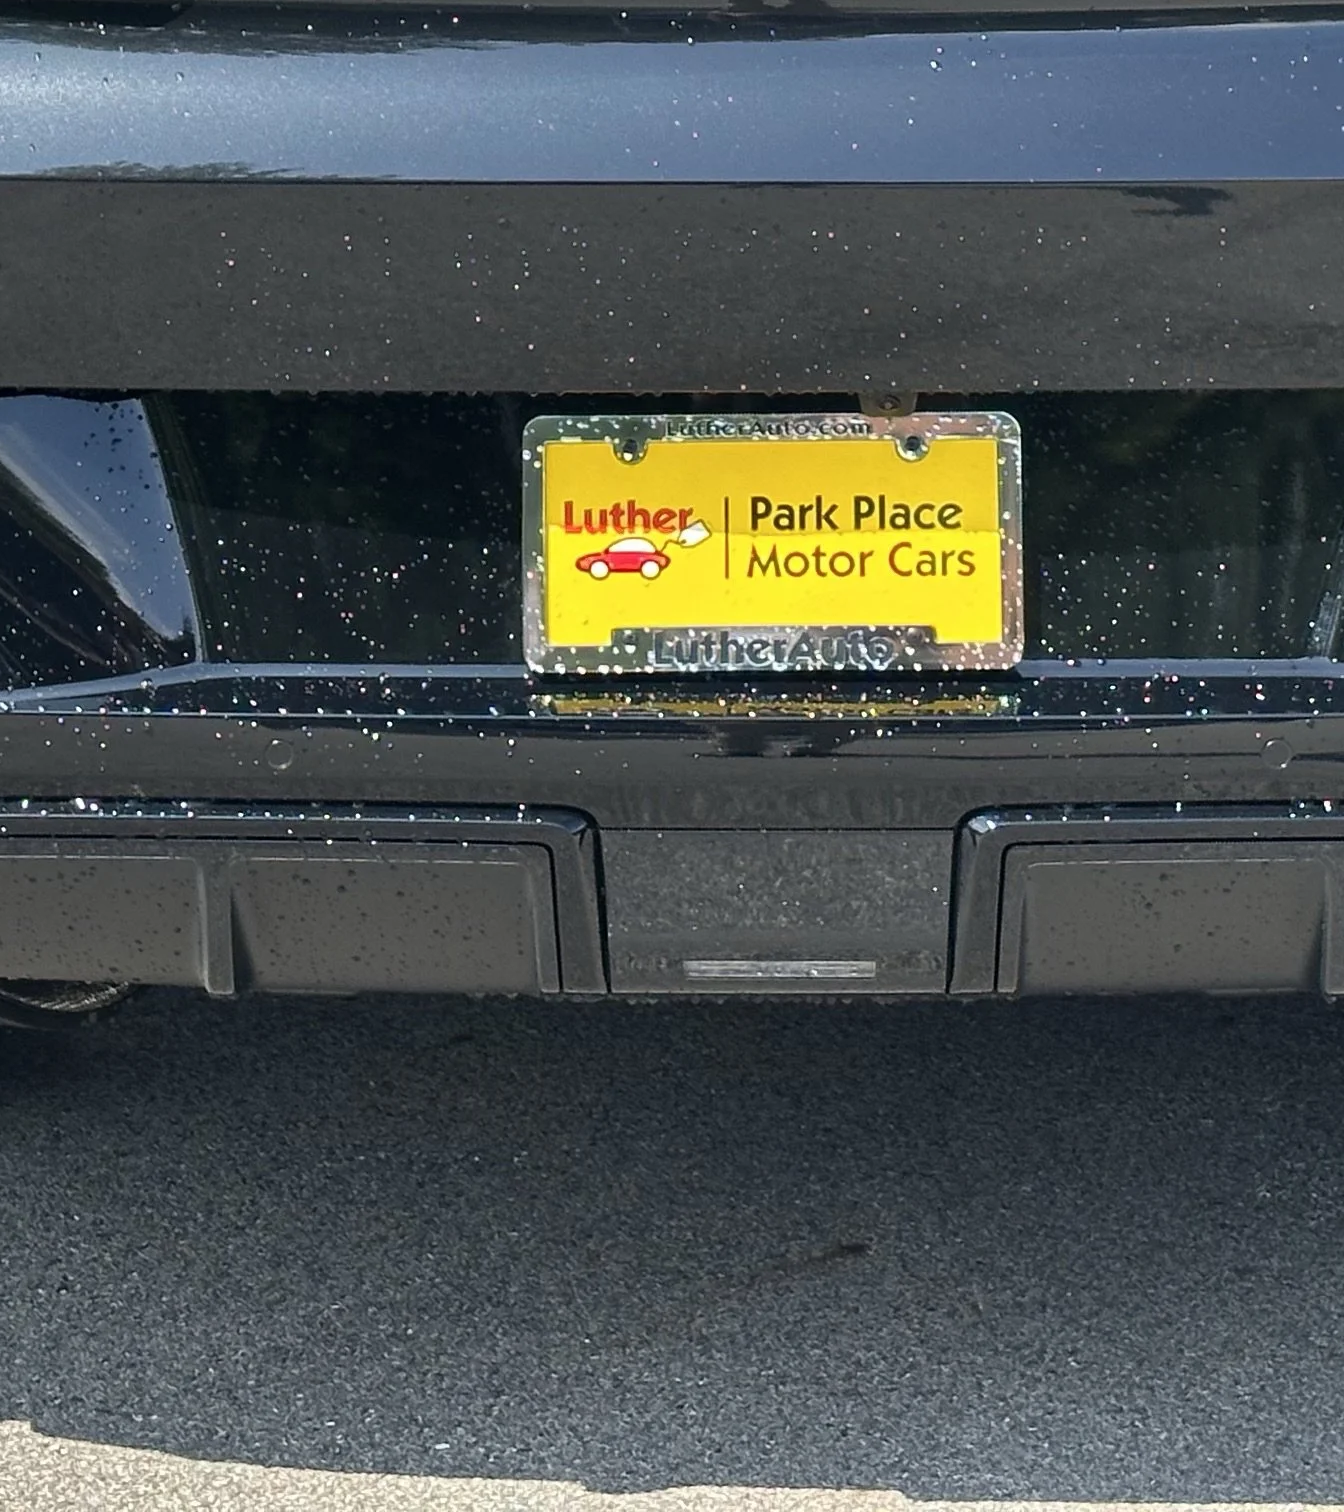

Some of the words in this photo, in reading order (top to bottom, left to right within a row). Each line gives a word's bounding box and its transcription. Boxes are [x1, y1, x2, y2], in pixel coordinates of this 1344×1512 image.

[665, 417, 872, 437] LutherAuto.com
[563, 499, 694, 534] Luther
[750, 494, 840, 531] Park
[853, 494, 964, 531] Place
[746, 543, 875, 578] Motor
[888, 541, 977, 577] Cars
